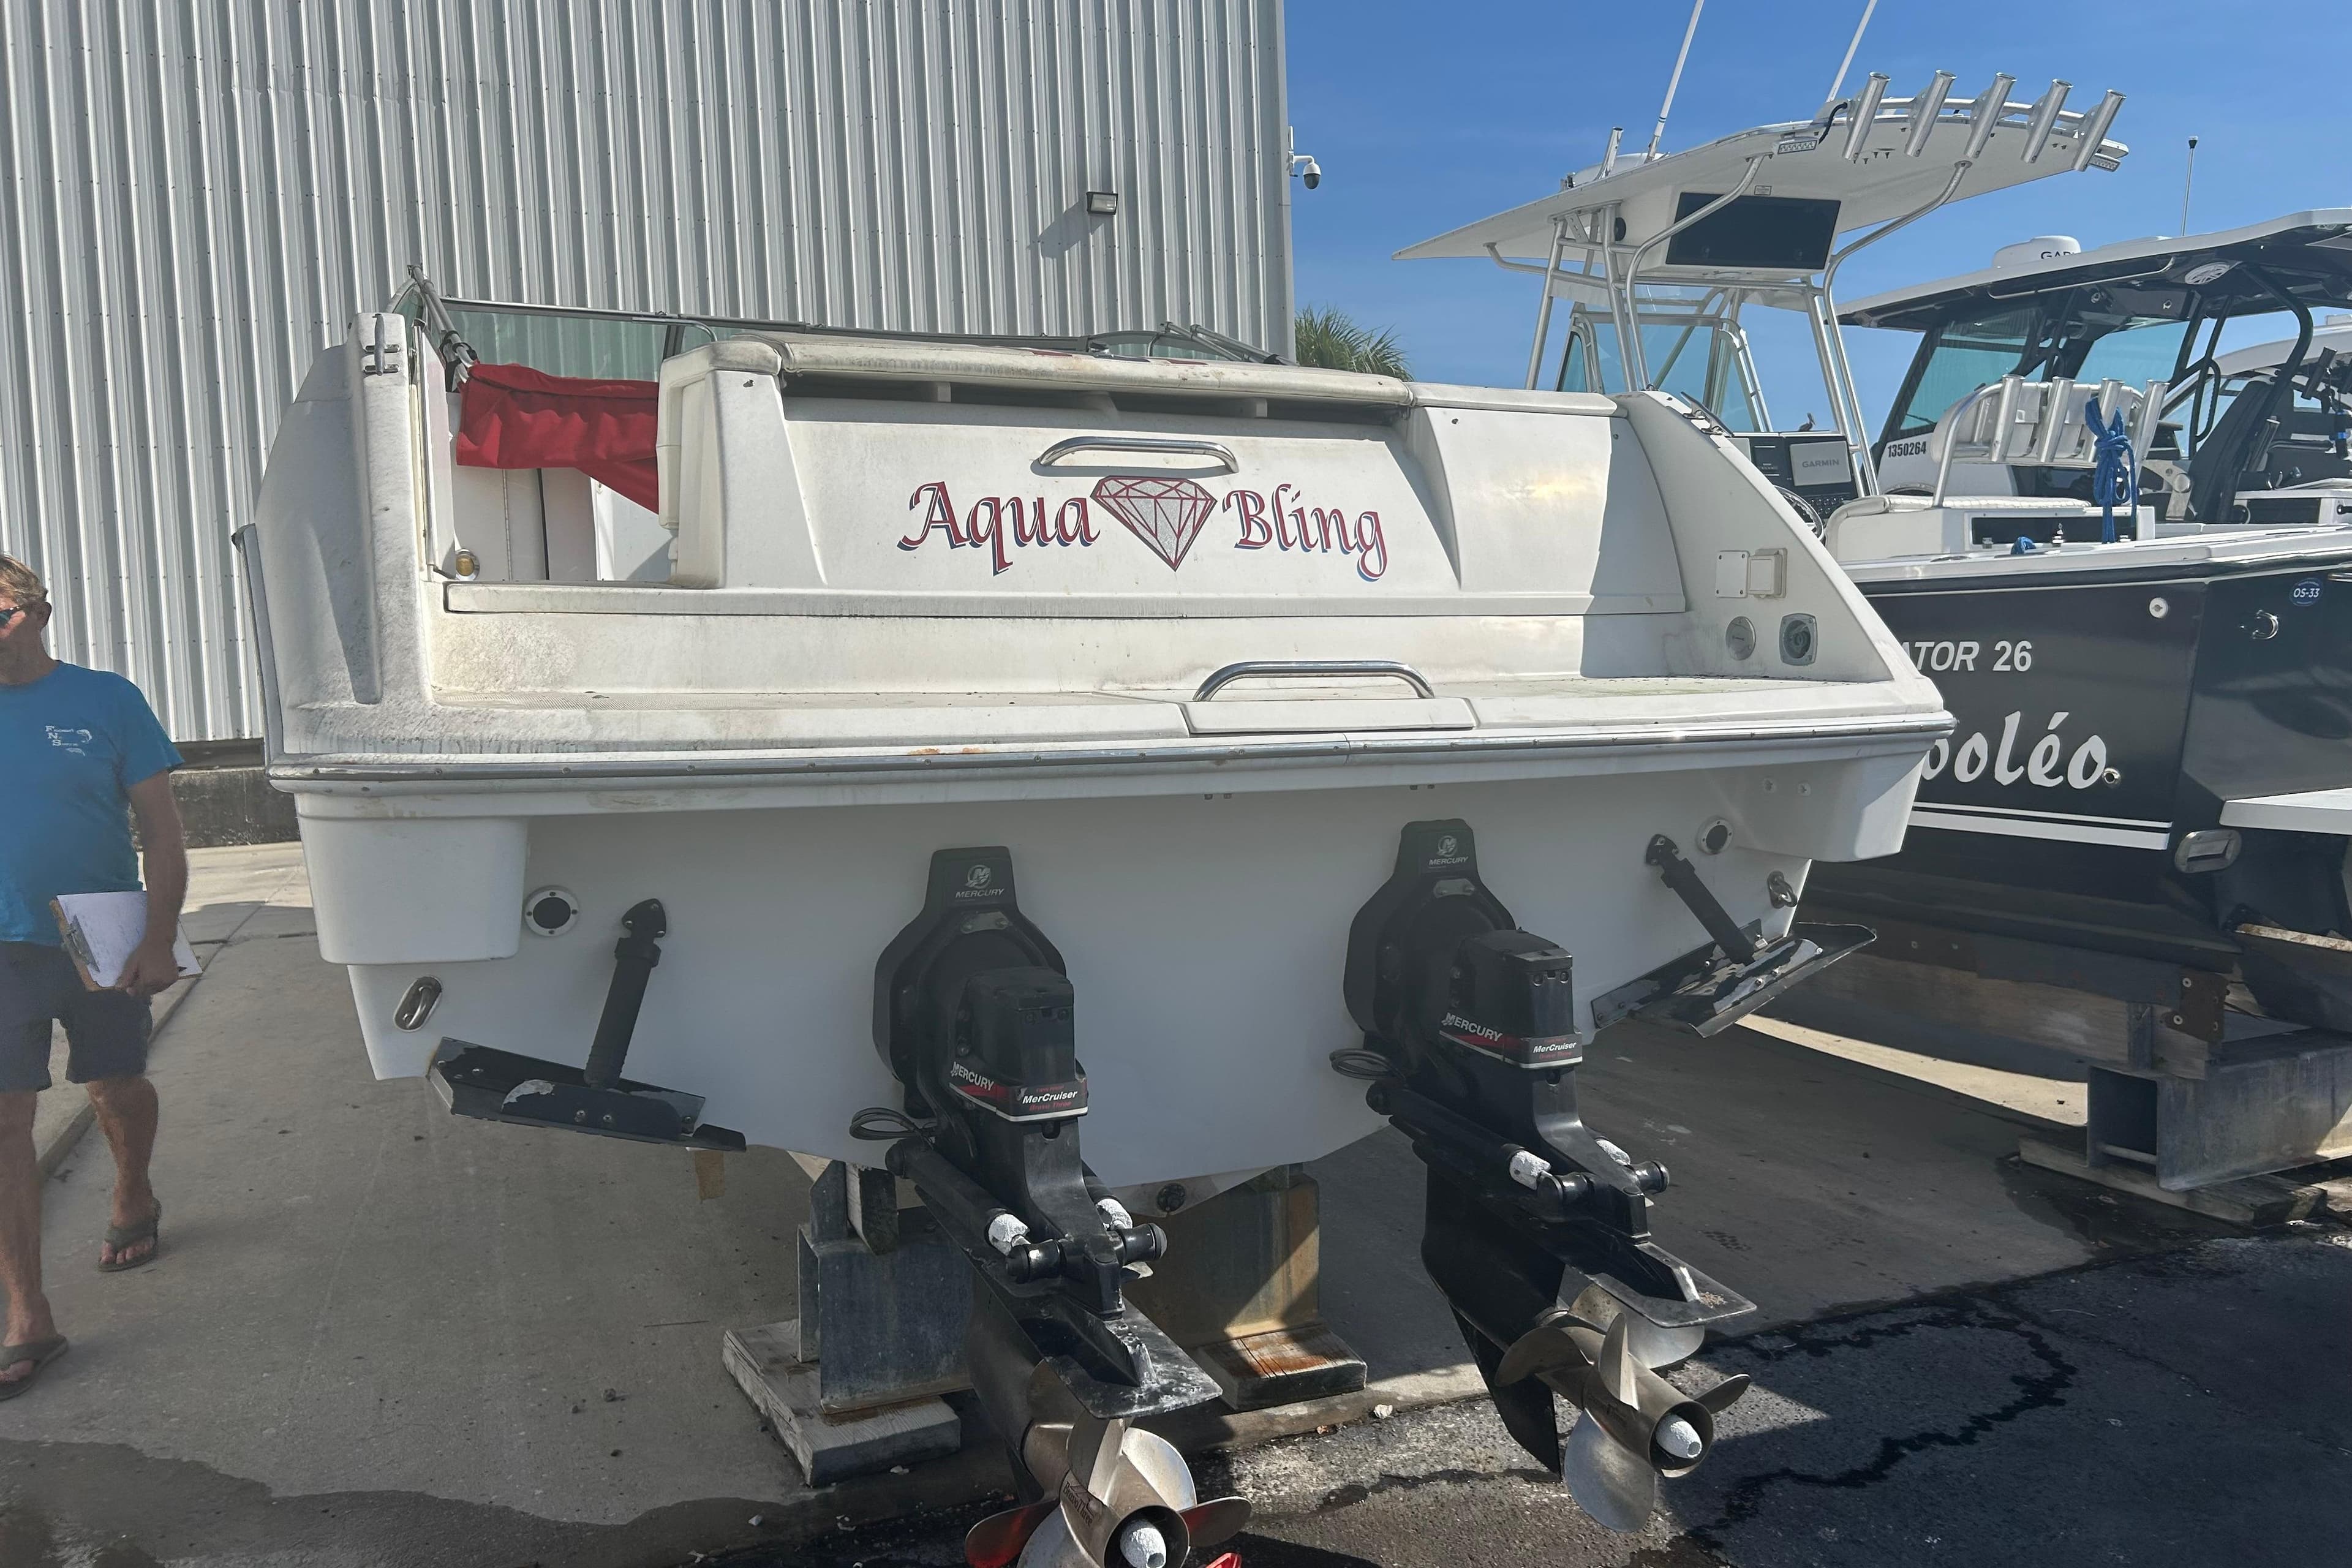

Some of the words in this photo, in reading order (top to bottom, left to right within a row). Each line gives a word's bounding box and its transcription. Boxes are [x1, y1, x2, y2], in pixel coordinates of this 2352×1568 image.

[1887, 441, 1927, 458] 1350264
[1801, 459, 1839, 469] GARMIN
[897, 480, 1101, 576] Aqua
[1223, 483, 1389, 582] Bling
[2293, 587, 2320, 598] OS-33
[1992, 640, 2032, 672] 26
[1429, 856, 1469, 865] MERCURY
[955, 888, 1005, 899] MERCURY
[1441, 1012, 1503, 1042] MERCURY
[1532, 1042, 1577, 1054] MerCruiser
[950, 1061, 995, 1091] MERCURY
[1022, 1090, 1078, 1104] MerCruiser
